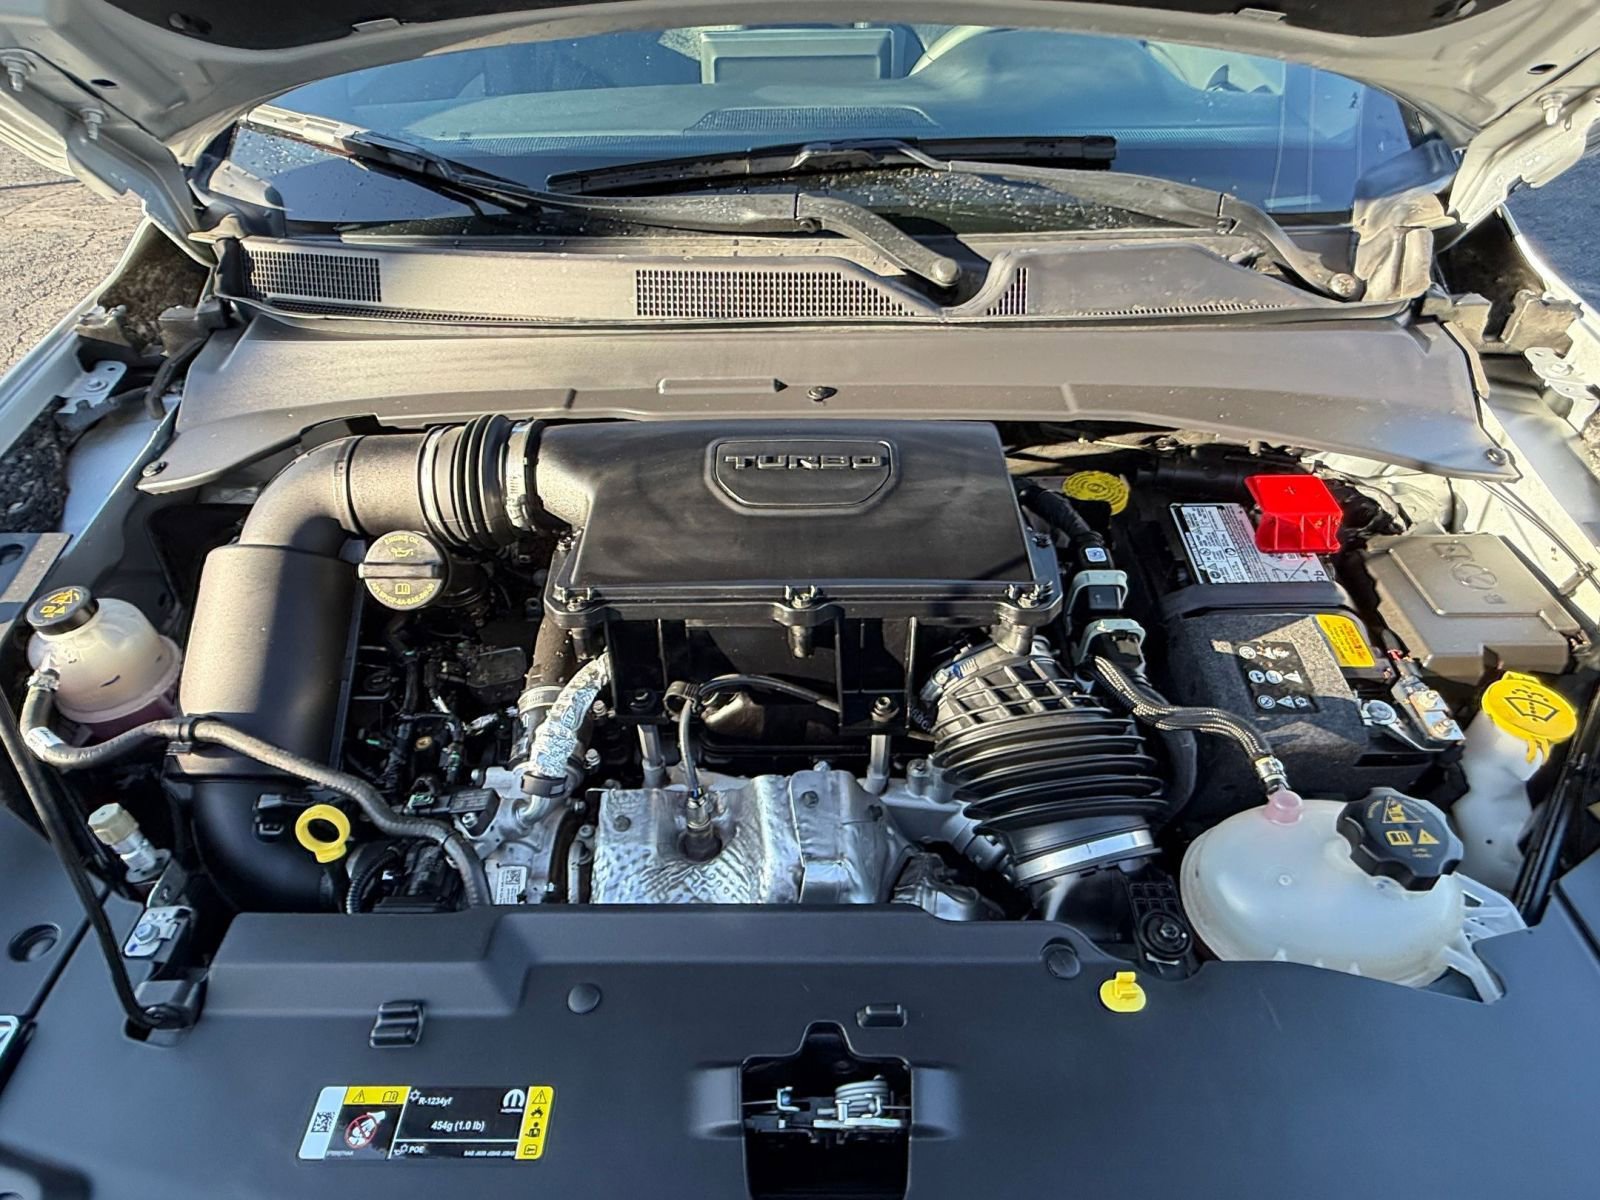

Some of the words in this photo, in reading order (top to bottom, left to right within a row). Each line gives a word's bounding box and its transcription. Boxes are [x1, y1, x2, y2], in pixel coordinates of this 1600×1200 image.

[725, 455, 881, 469] TURBO
[418, 1096, 453, 1107] R-1234yf
[430, 1120, 453, 1132] 454g
[454, 1120, 472, 1132] (1.0
[472, 1120, 485, 1132] lb)
[408, 1146, 425, 1154] POE
